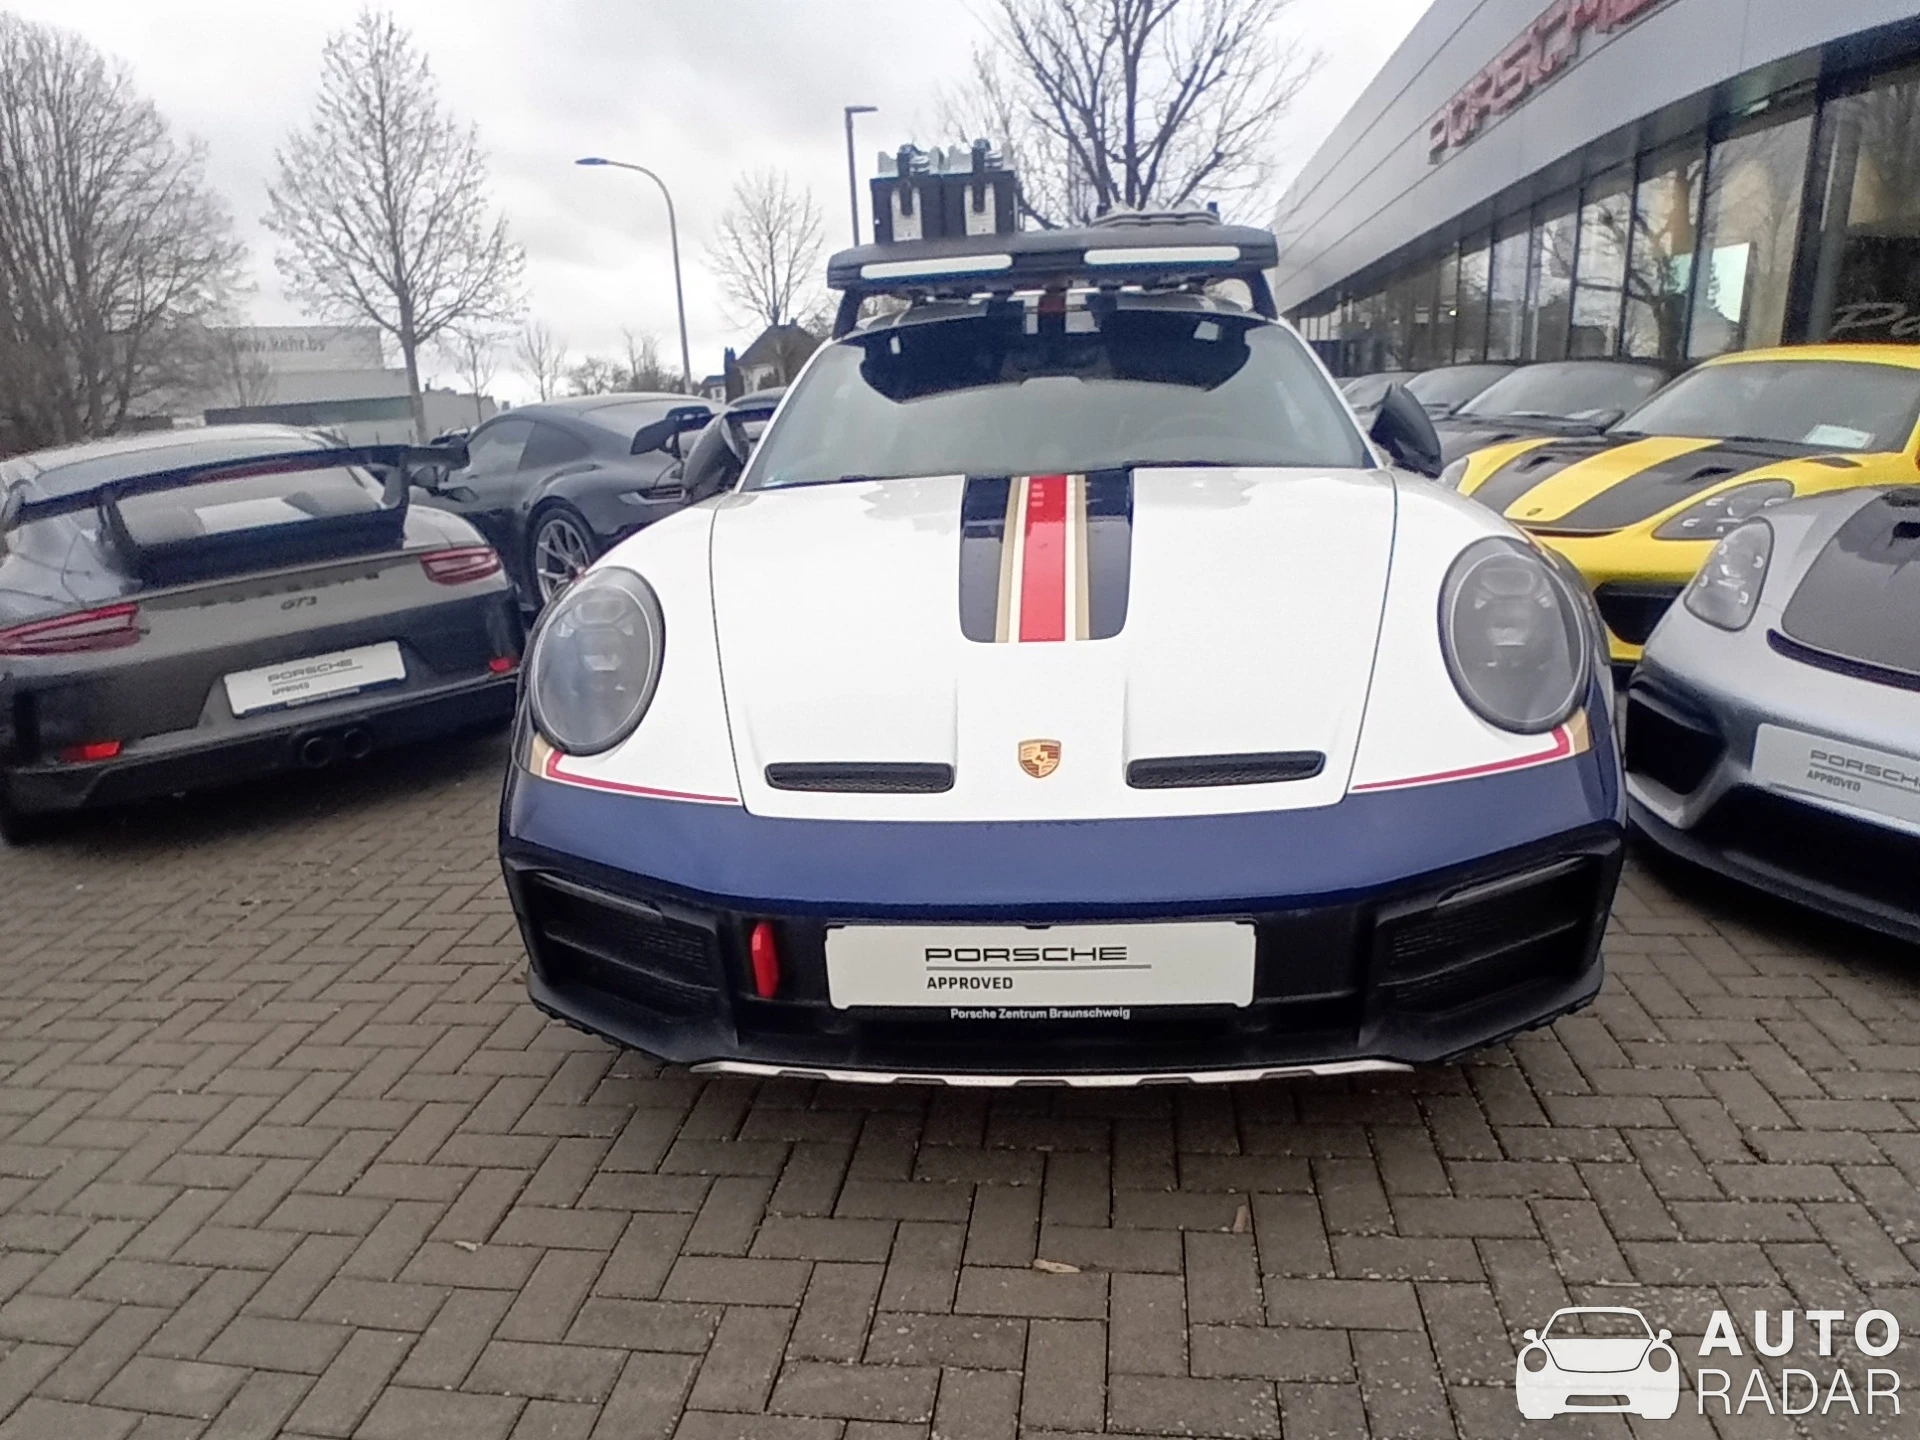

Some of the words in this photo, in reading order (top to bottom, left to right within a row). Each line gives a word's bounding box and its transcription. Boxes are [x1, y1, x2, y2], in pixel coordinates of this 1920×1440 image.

[280, 595, 318, 611] GT3
[267, 658, 353, 682] PORSCHE
[1810, 750, 1920, 787] PORSCH
[1806, 769, 1861, 792] APPROVED
[925, 946, 1127, 962] PORSCHE
[926, 976, 1014, 990] APPROVED
[950, 1008, 997, 1019] Porsche
[998, 1008, 1047, 1019] Zentrum
[1049, 1007, 1131, 1020] Braunschweig
